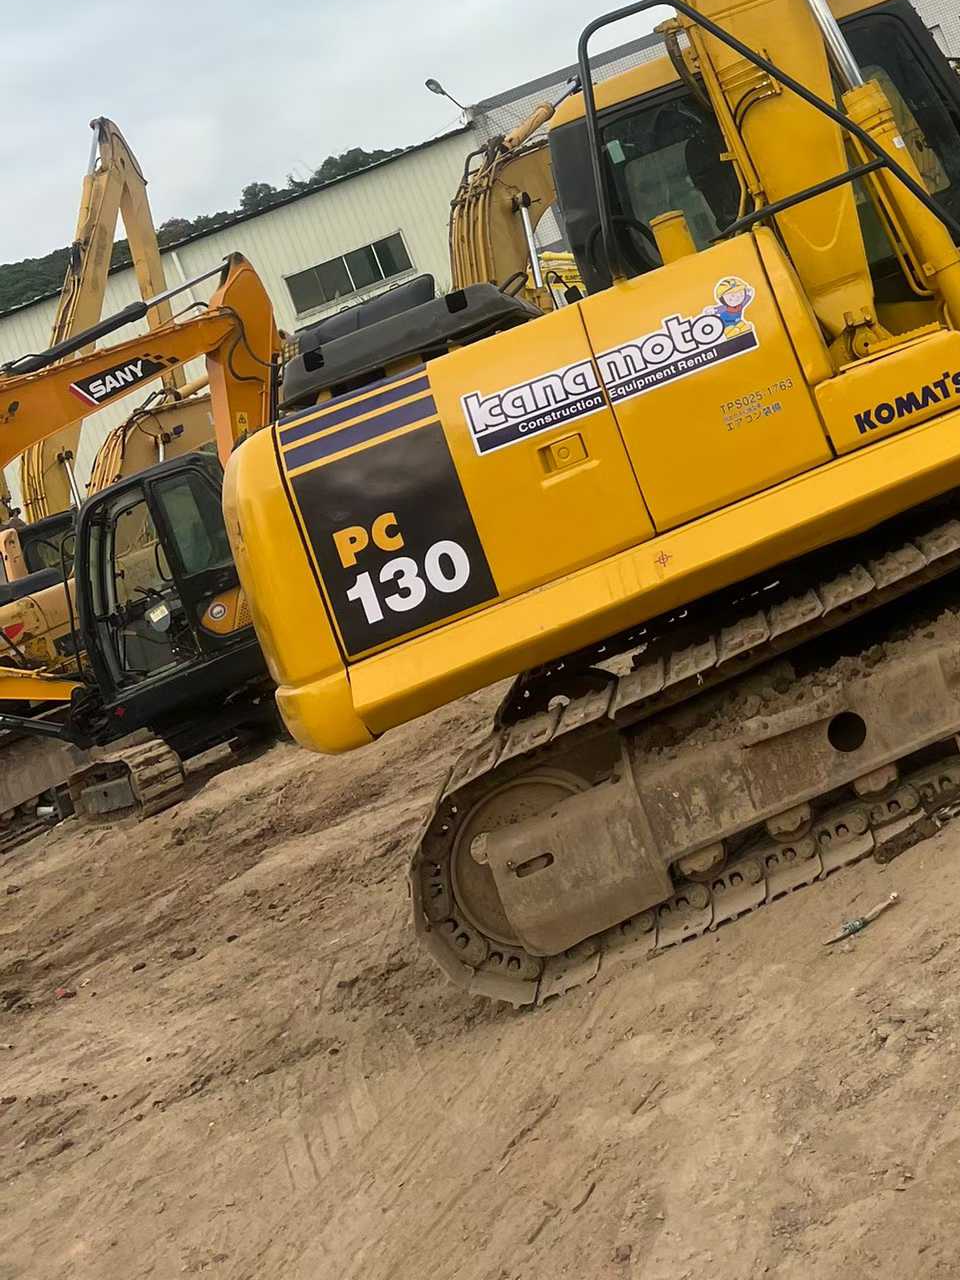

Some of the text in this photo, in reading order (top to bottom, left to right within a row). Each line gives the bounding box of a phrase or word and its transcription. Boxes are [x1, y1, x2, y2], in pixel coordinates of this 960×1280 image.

[88, 360, 143, 399] SANY
[463, 313, 726, 434] kanamoto
[518, 348, 719, 433] Construction Equipment Rental
[332, 512, 405, 569] PC
[346, 539, 471, 625] 130
